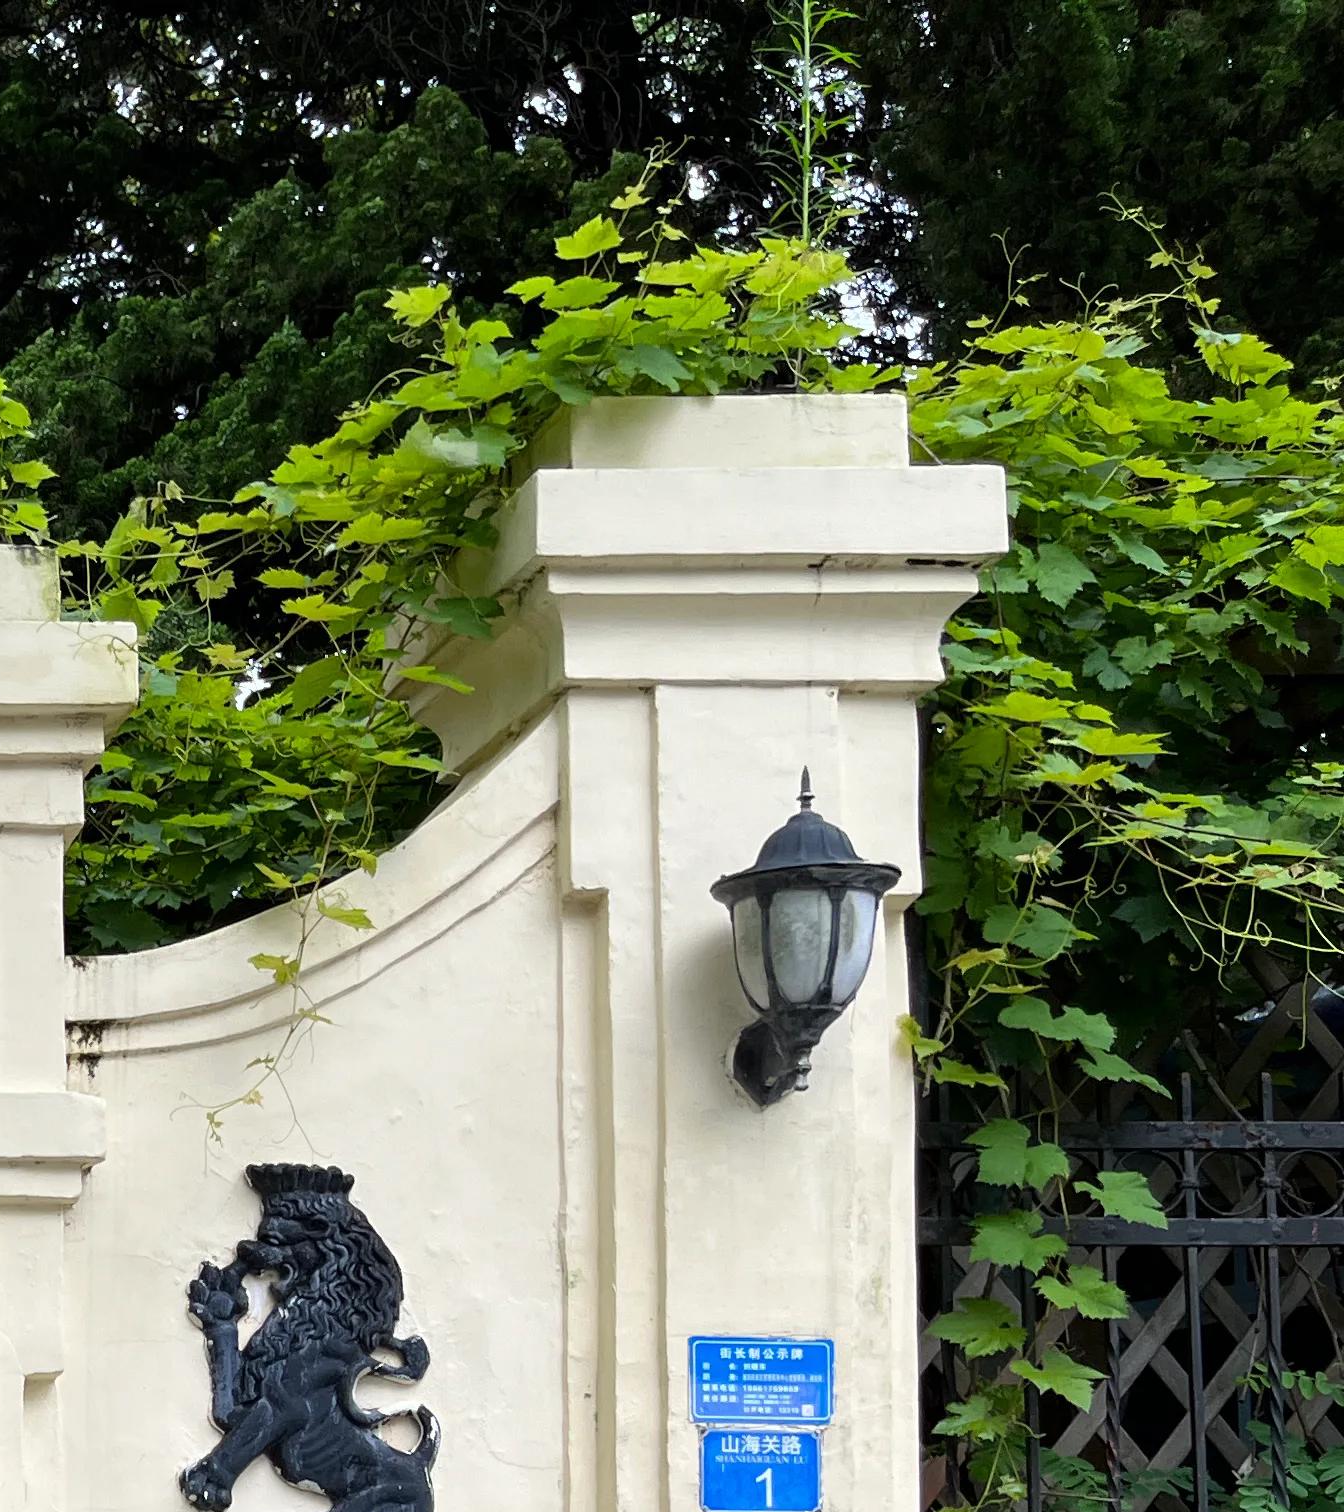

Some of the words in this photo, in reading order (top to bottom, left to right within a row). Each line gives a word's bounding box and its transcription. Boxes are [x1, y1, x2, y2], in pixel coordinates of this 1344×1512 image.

[721, 1434, 802, 1455] 山海关路
[755, 1467, 773, 1509] 1
